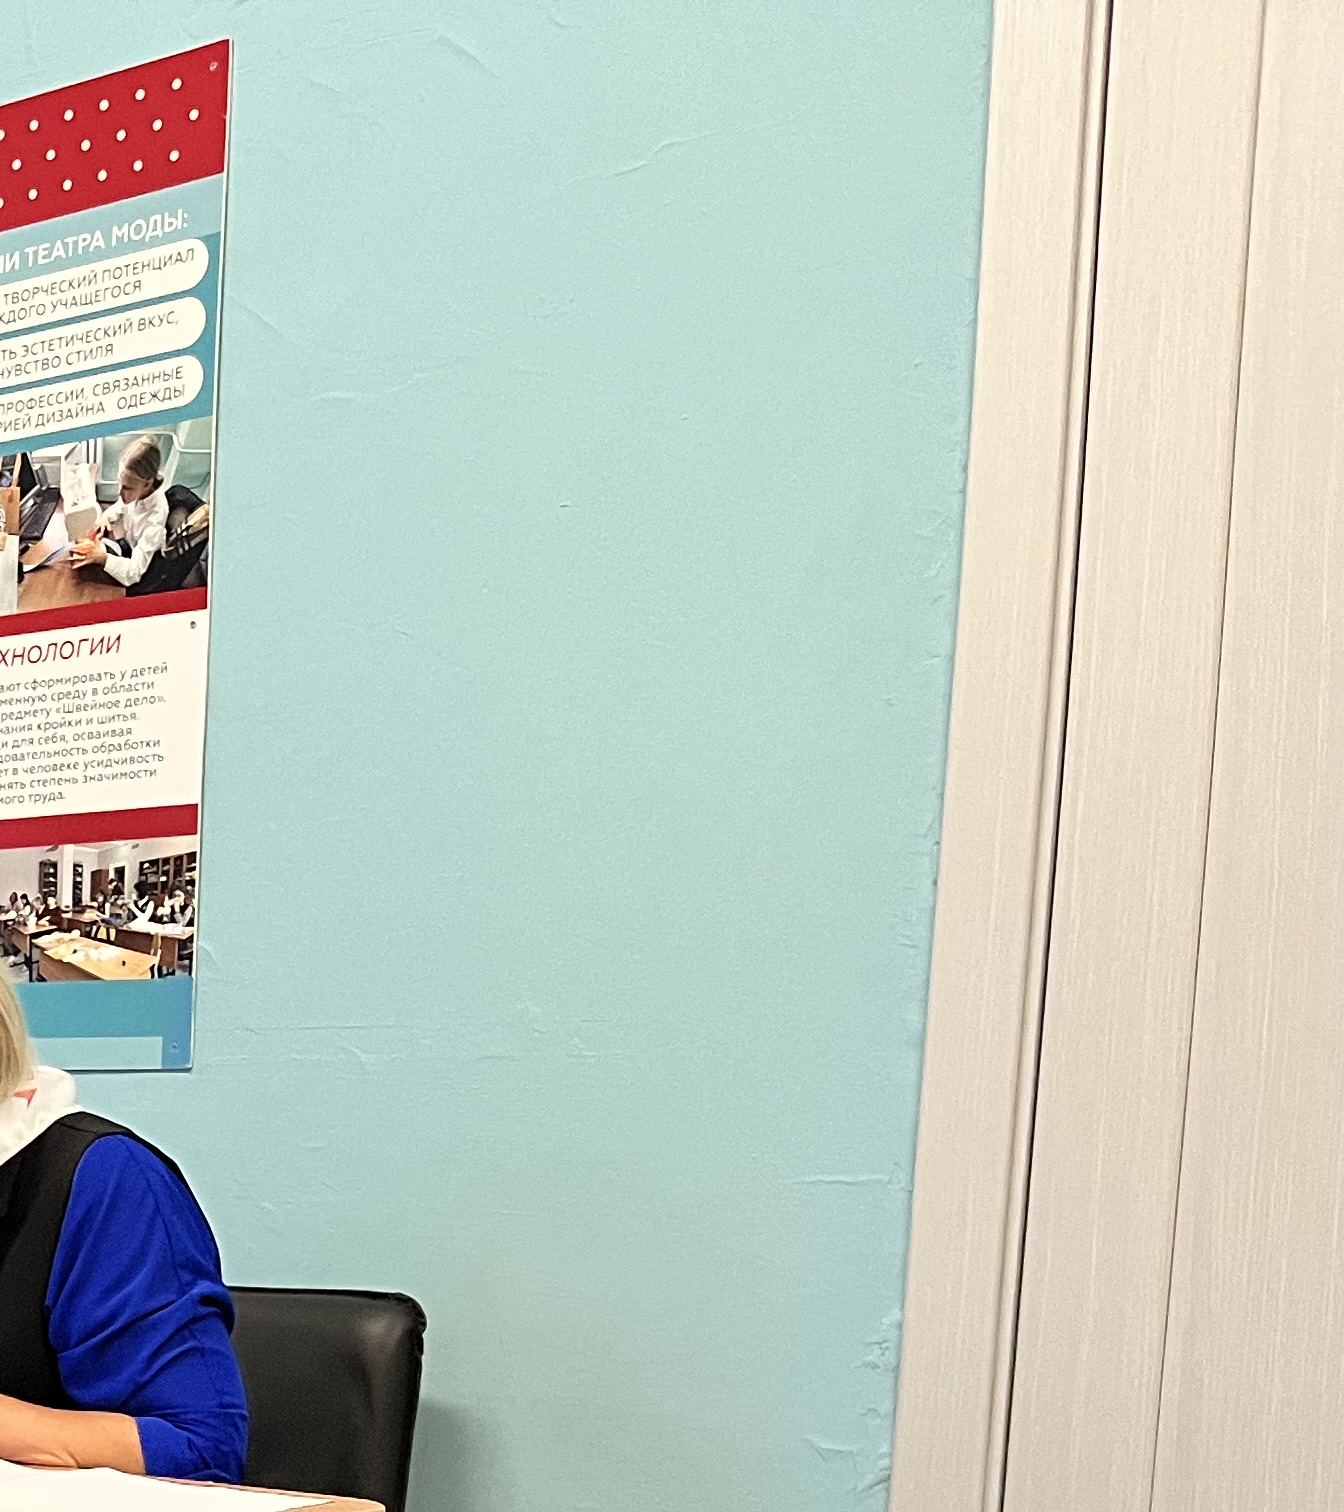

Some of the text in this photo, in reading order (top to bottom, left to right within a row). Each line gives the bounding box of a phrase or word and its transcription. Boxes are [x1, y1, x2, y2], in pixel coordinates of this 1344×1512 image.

[23, 229, 106, 267] ТЕАТРА
[111, 208, 188, 247] МОДЫ:
[3, 269, 97, 305] ТВОРЧЕСКИЙ
[101, 247, 194, 283] ПОТЕНЦИАЛ
[50, 279, 141, 313] УЧАЩЕГОСЯ
[20, 318, 133, 357] ЭСТЕТИЧЕСКИЙ
[137, 310, 179, 332] ВКУС,
[65, 343, 113, 365] СТИЛЯ
[92, 365, 183, 396] СВЯЗАННЫЕ
[34, 401, 105, 429] ДИЗАЙНА
[116, 384, 184, 410] ОДЕЖДЫ
